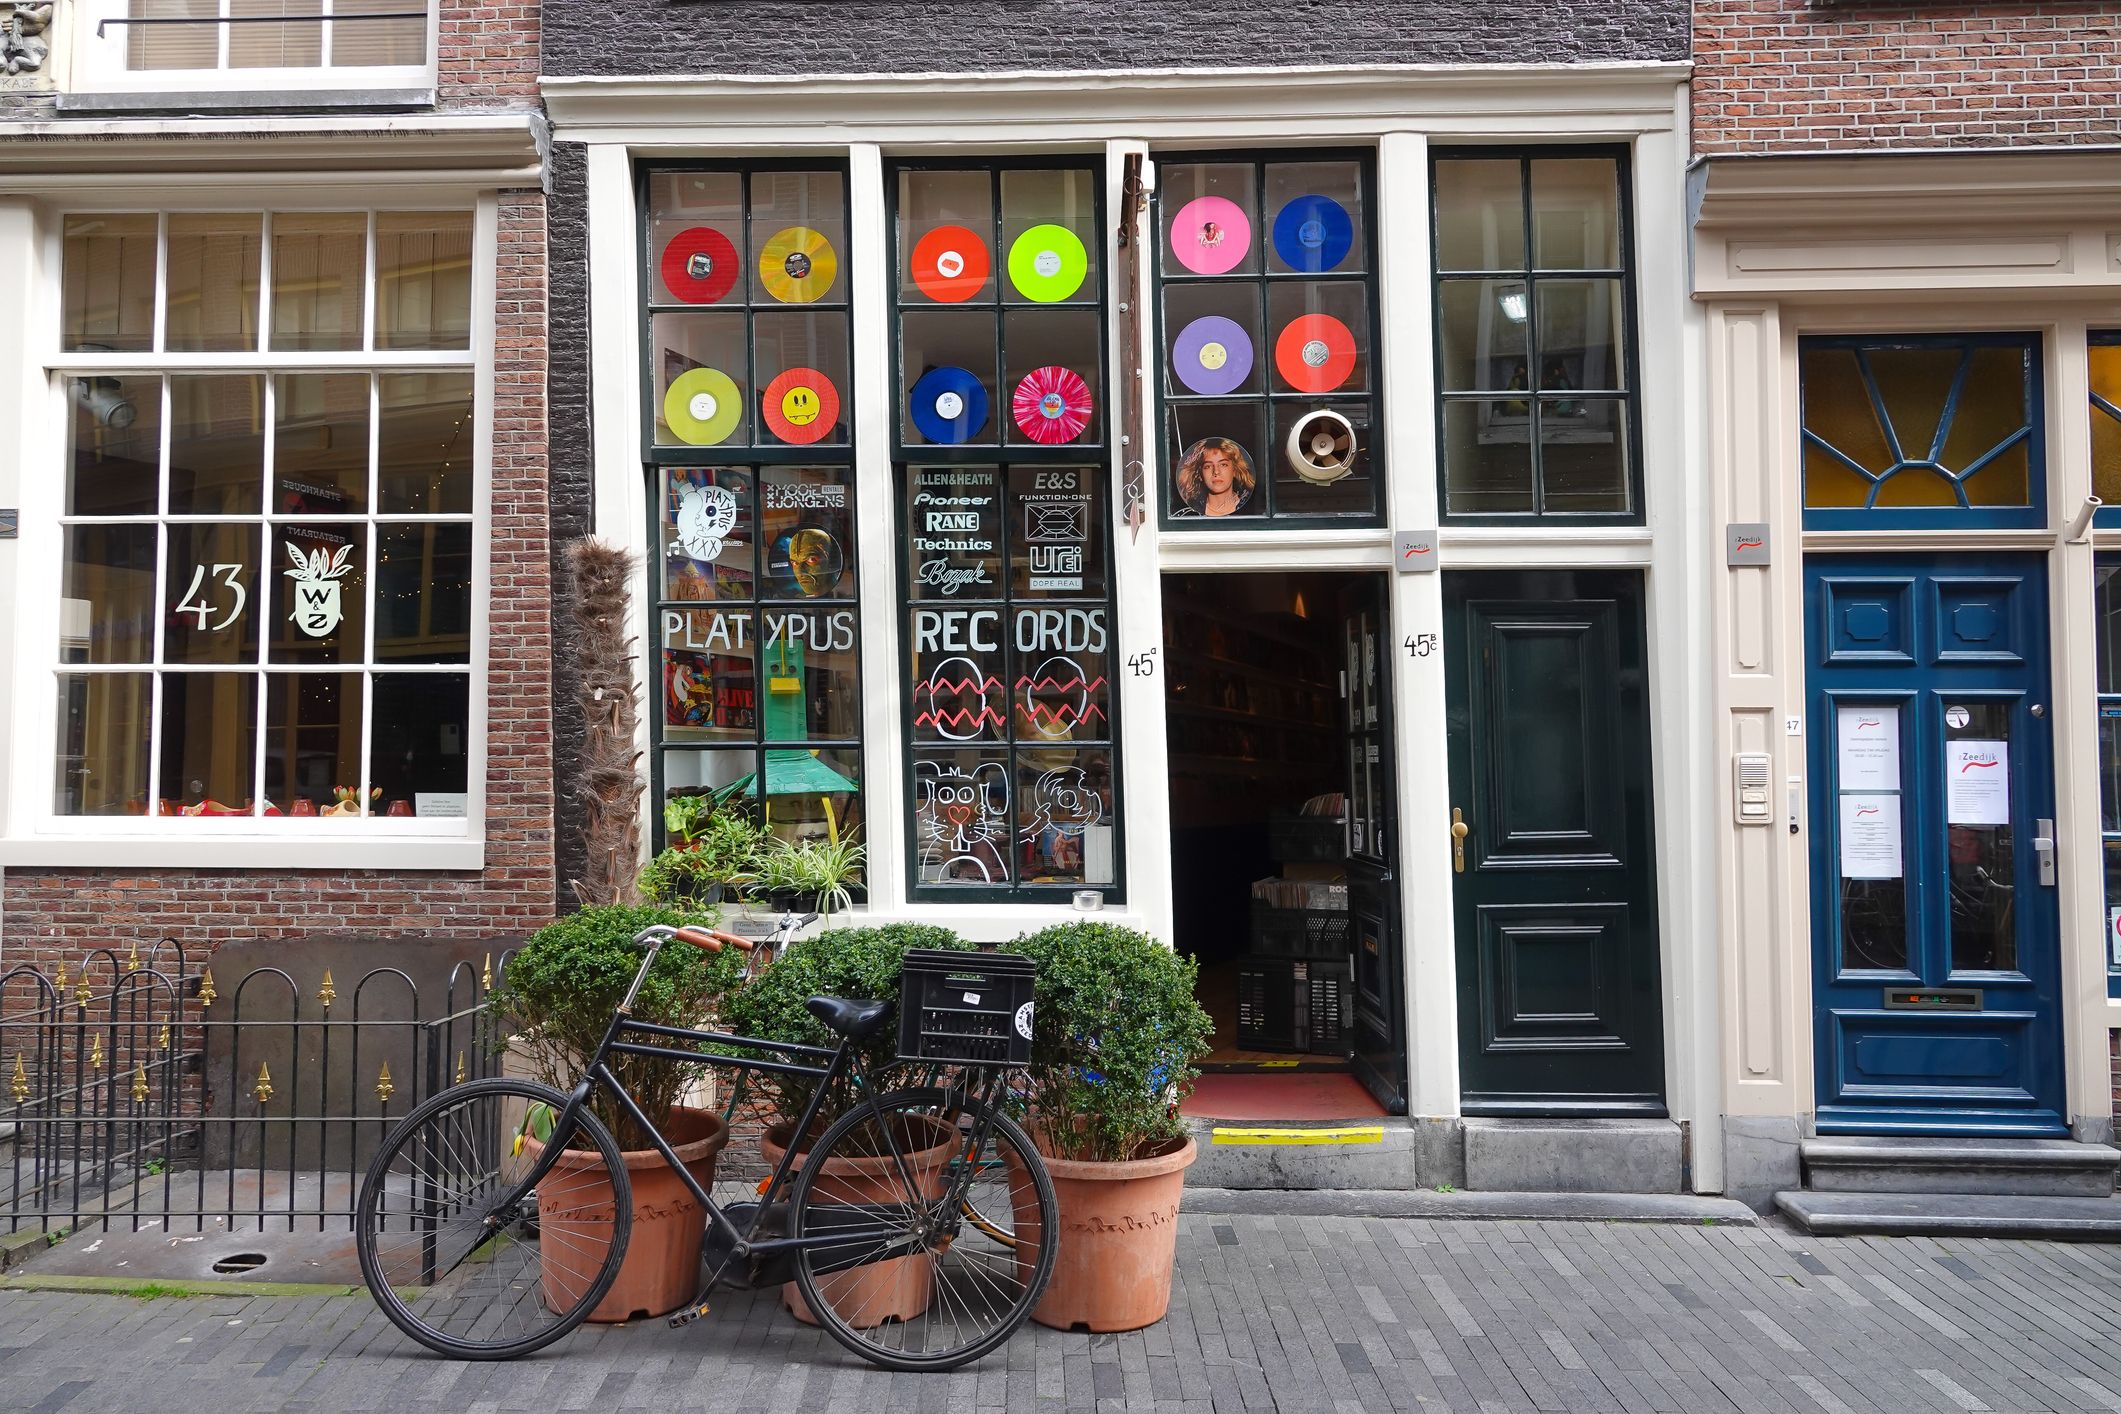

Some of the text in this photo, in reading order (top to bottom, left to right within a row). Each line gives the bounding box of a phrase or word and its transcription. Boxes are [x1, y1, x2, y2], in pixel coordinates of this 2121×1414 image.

[914, 473, 993, 486] ALLEN&HEATH
[1035, 473, 1077, 490] E&S
[776, 495, 845, 508] JONGENS
[914, 492, 992, 506] Pioneer
[704, 490, 734, 530] PLATYPUS
[926, 512, 979, 531] RANE
[914, 538, 992, 550] Technics
[914, 557, 993, 595] Bozak
[175, 564, 246, 631] 43
[302, 588, 331, 605] W
[308, 614, 328, 629] Z
[1786, 720, 1799, 730] 47
